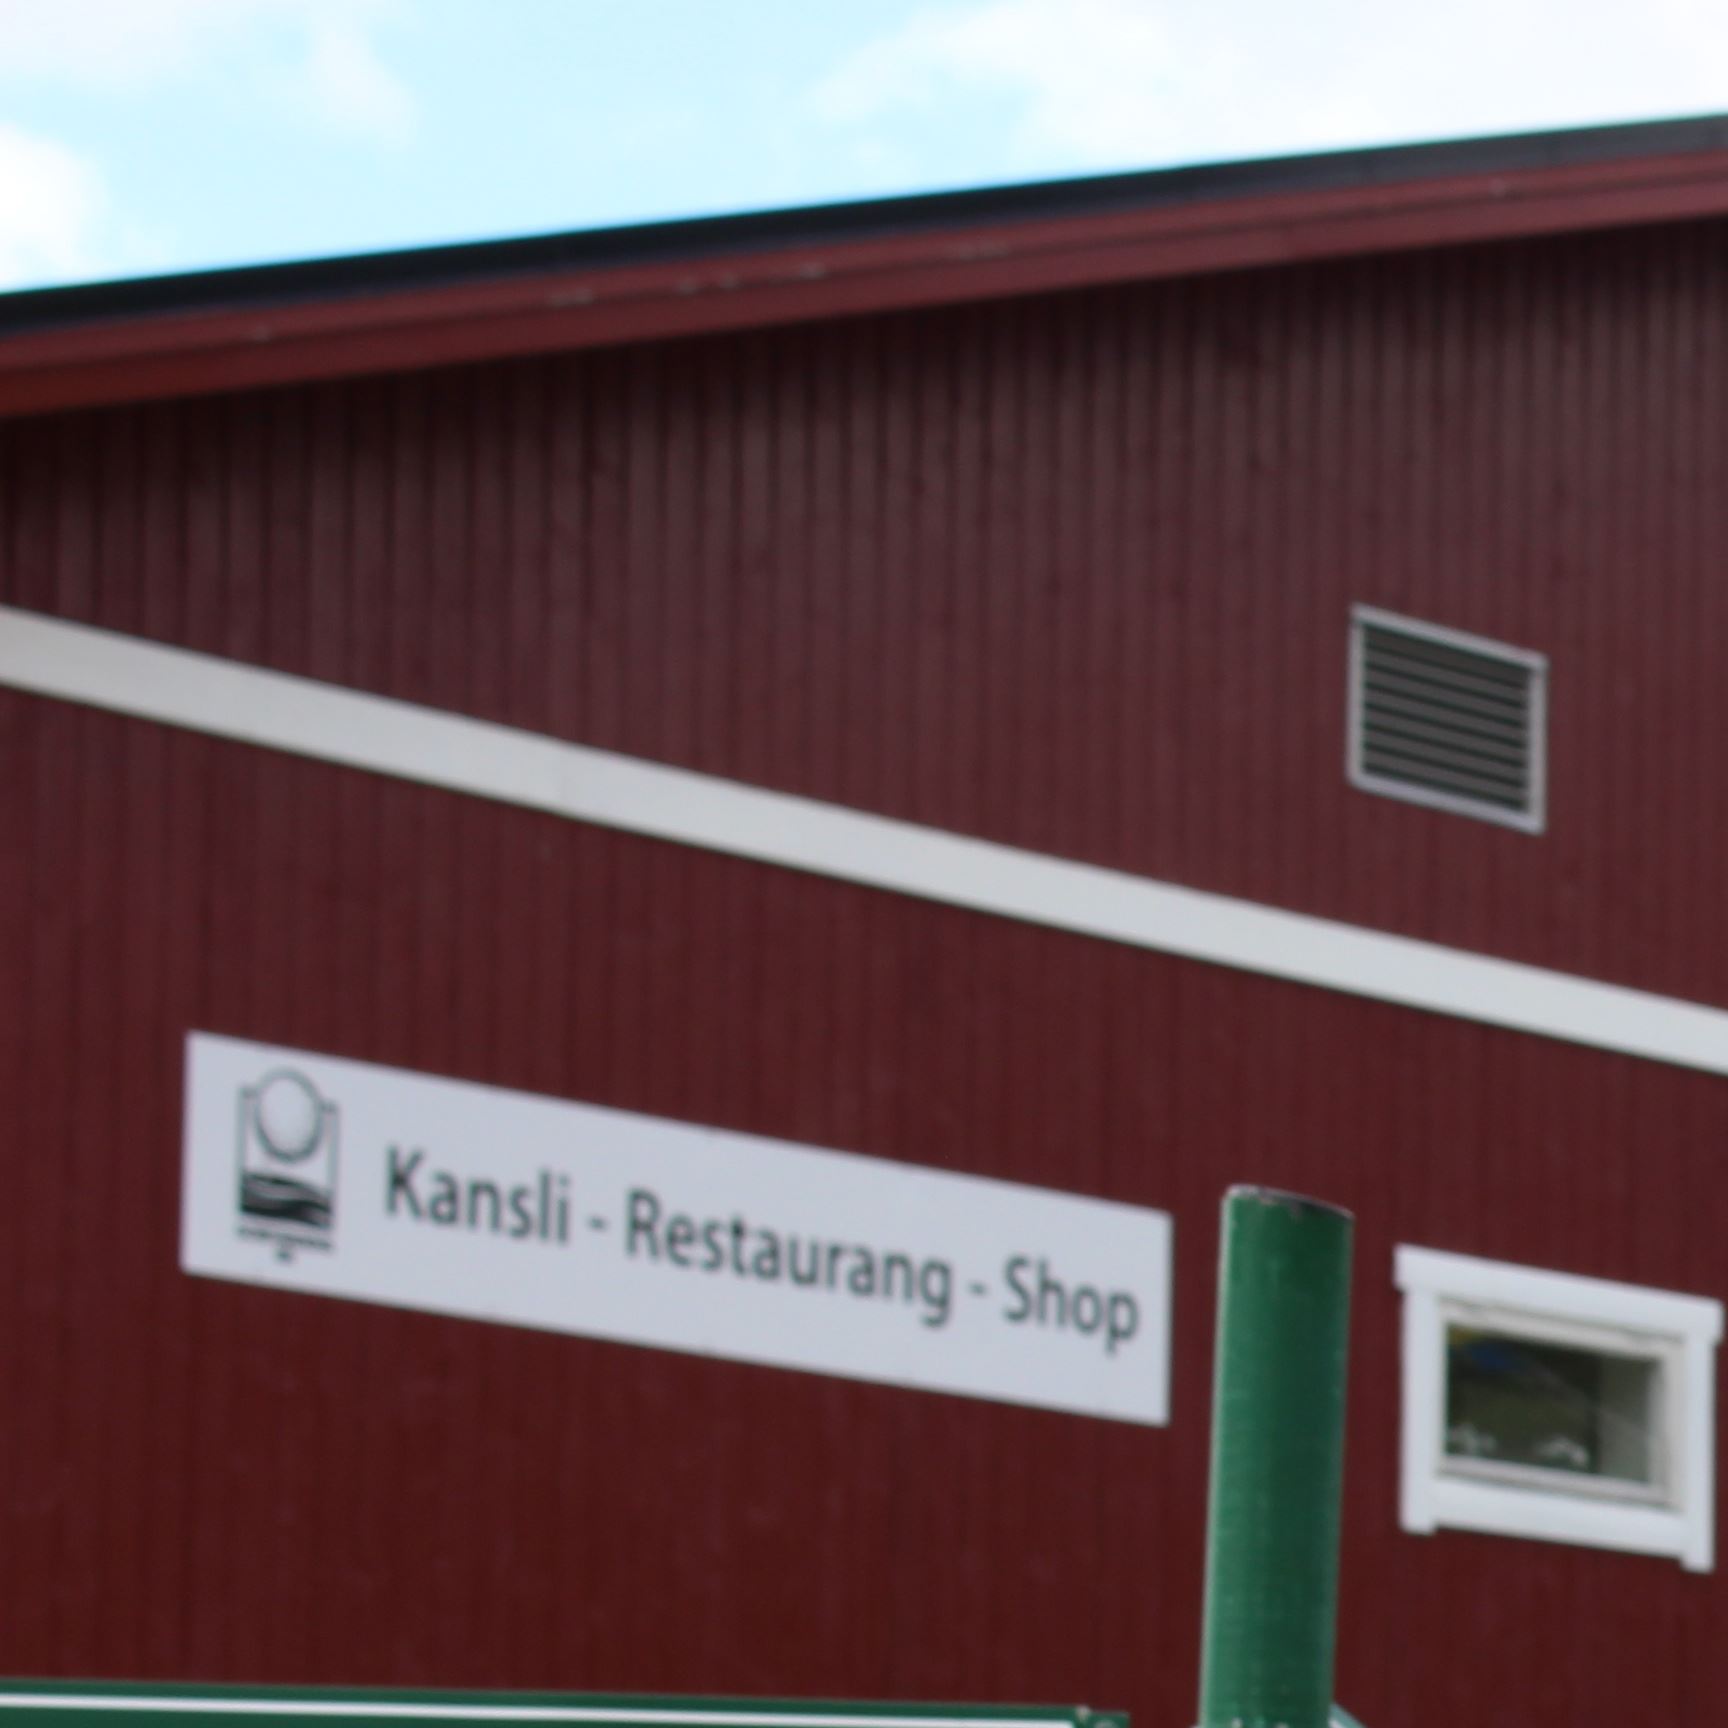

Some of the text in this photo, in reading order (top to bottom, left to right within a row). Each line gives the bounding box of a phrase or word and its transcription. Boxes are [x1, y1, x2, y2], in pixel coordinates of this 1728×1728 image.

[385, 1147, 569, 1243] Kansli
[626, 1188, 952, 1328] Restaurang
[1004, 1254, 1138, 1351] Shop
